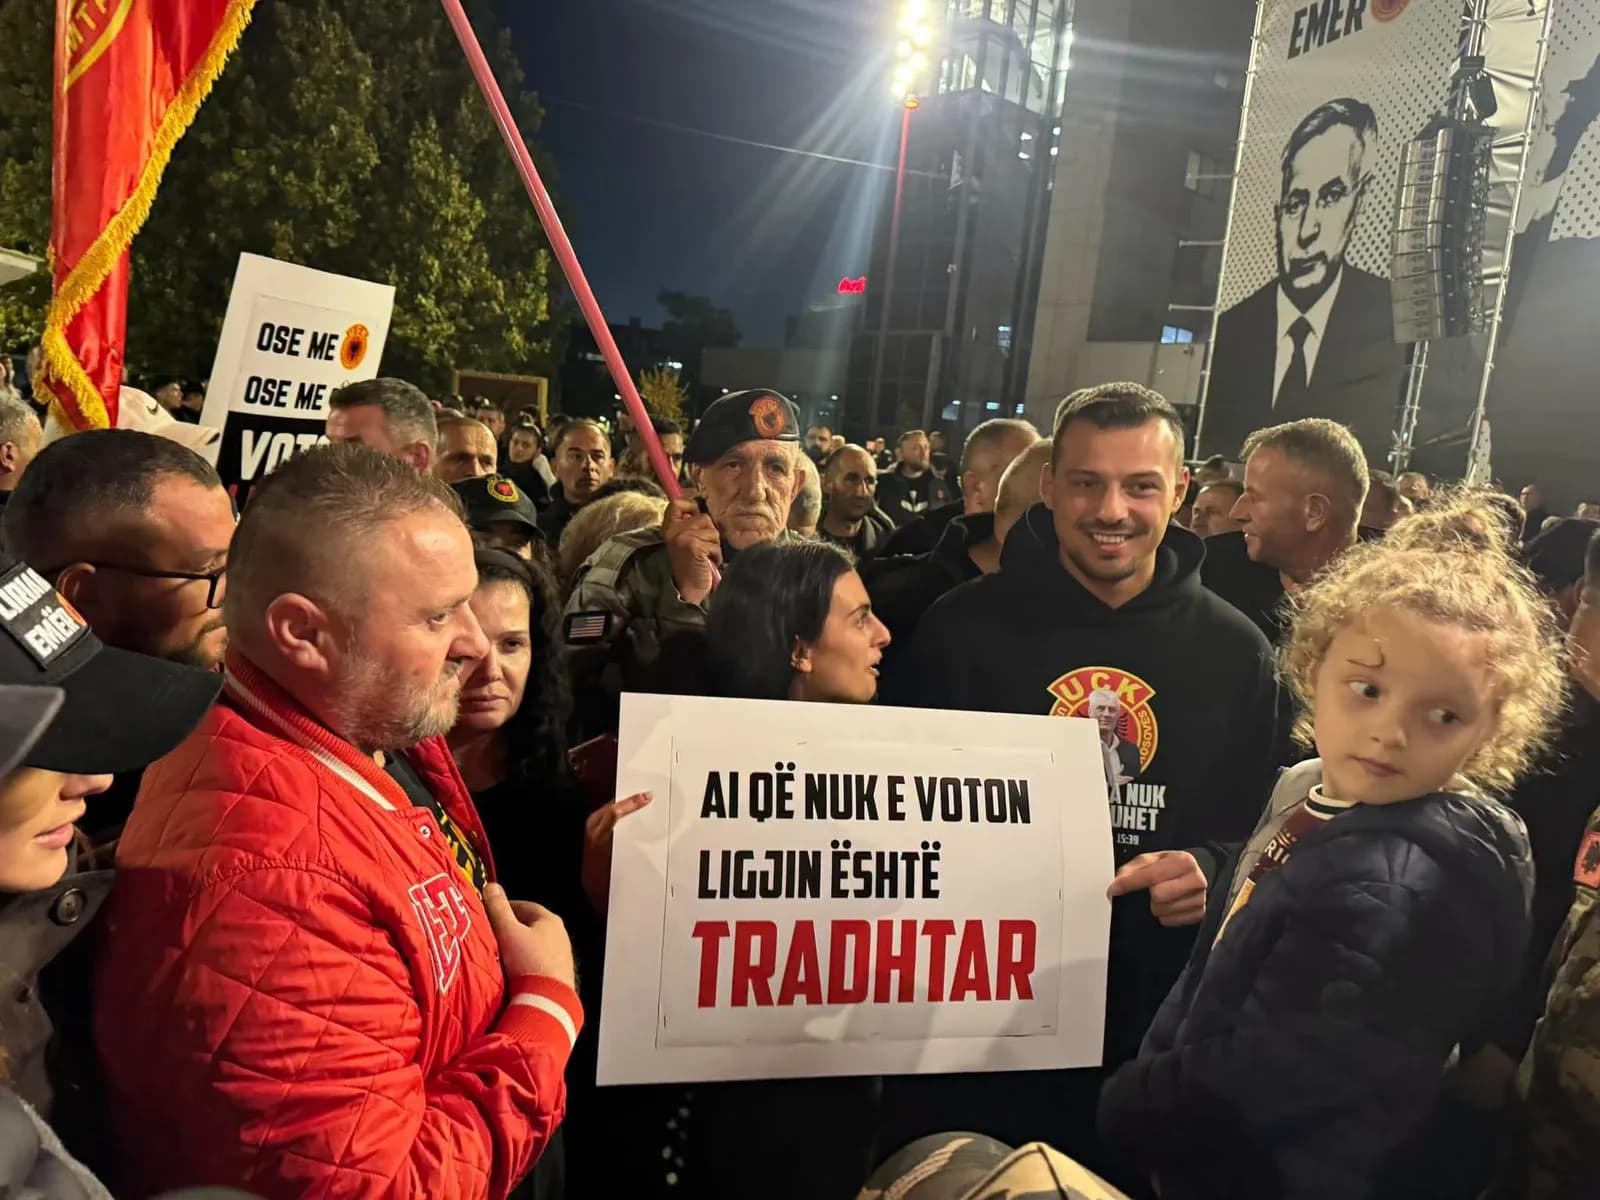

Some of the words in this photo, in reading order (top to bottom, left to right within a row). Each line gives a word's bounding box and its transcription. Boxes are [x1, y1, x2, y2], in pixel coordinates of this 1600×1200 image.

[257, 322, 304, 357] OSE
[307, 331, 339, 361] ME
[244, 376, 291, 408] OSE
[294, 382, 326, 410] ME
[700, 771, 739, 819] AI
[749, 762, 796, 823] QË
[805, 773, 879, 821] NUK
[888, 775, 906, 821] E
[914, 776, 1031, 824] VOTON
[1126, 783, 1166, 808] NUK
[1110, 804, 1159, 831] UHET
[698, 849, 821, 899] LIGJIN
[831, 839, 941, 899] ËSHTË
[692, 919, 1037, 1008] TRADHTAR
